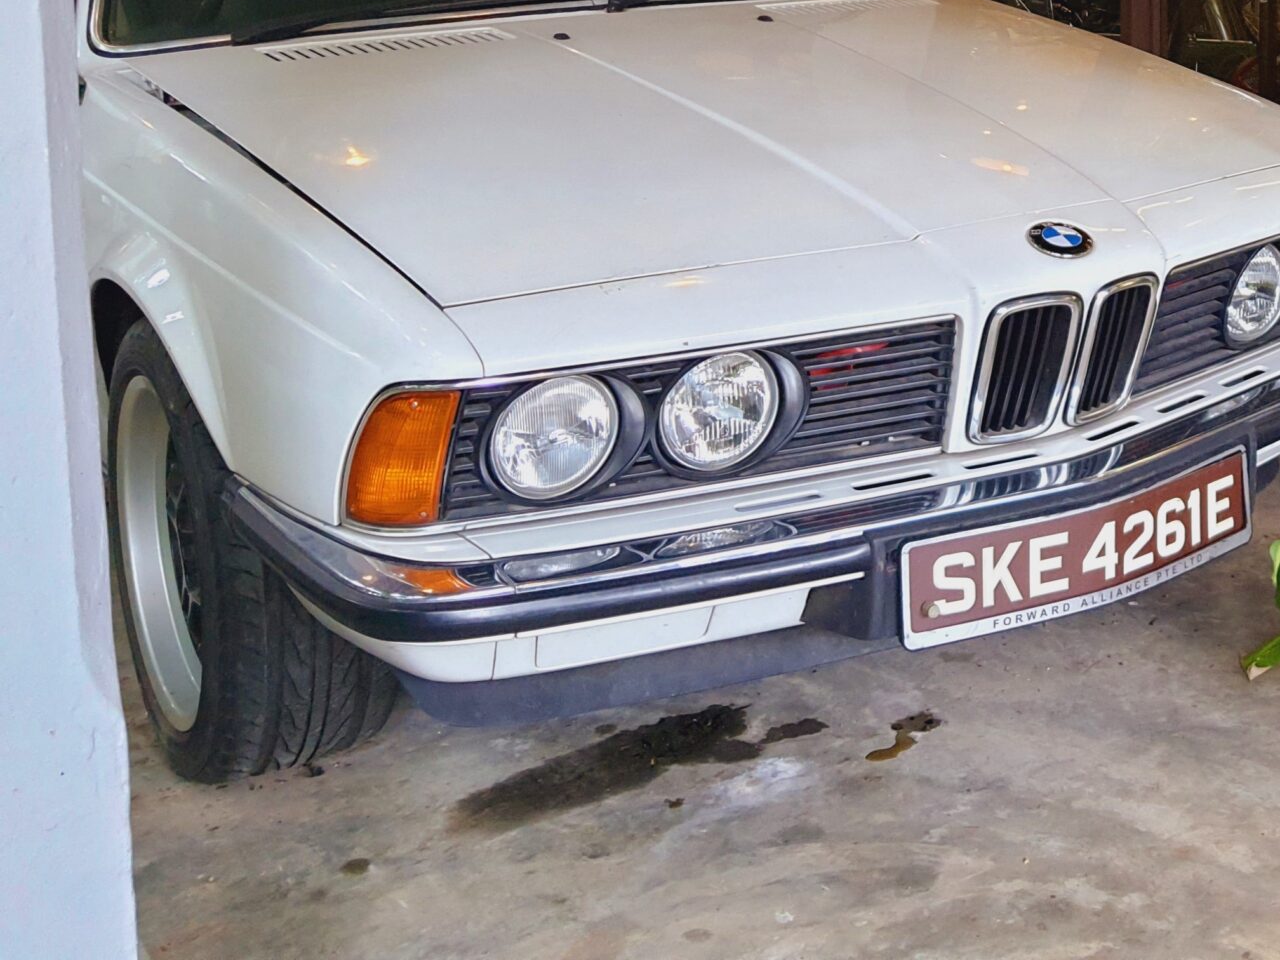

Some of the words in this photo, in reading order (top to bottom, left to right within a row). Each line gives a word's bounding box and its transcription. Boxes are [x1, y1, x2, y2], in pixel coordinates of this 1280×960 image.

[932, 531, 1070, 617] SKE
[1081, 474, 1235, 581] 4261E
[993, 602, 1071, 629] FORWARD
[1080, 576, 1150, 608] ALLIANCE
[1156, 565, 1178, 581] PTE
